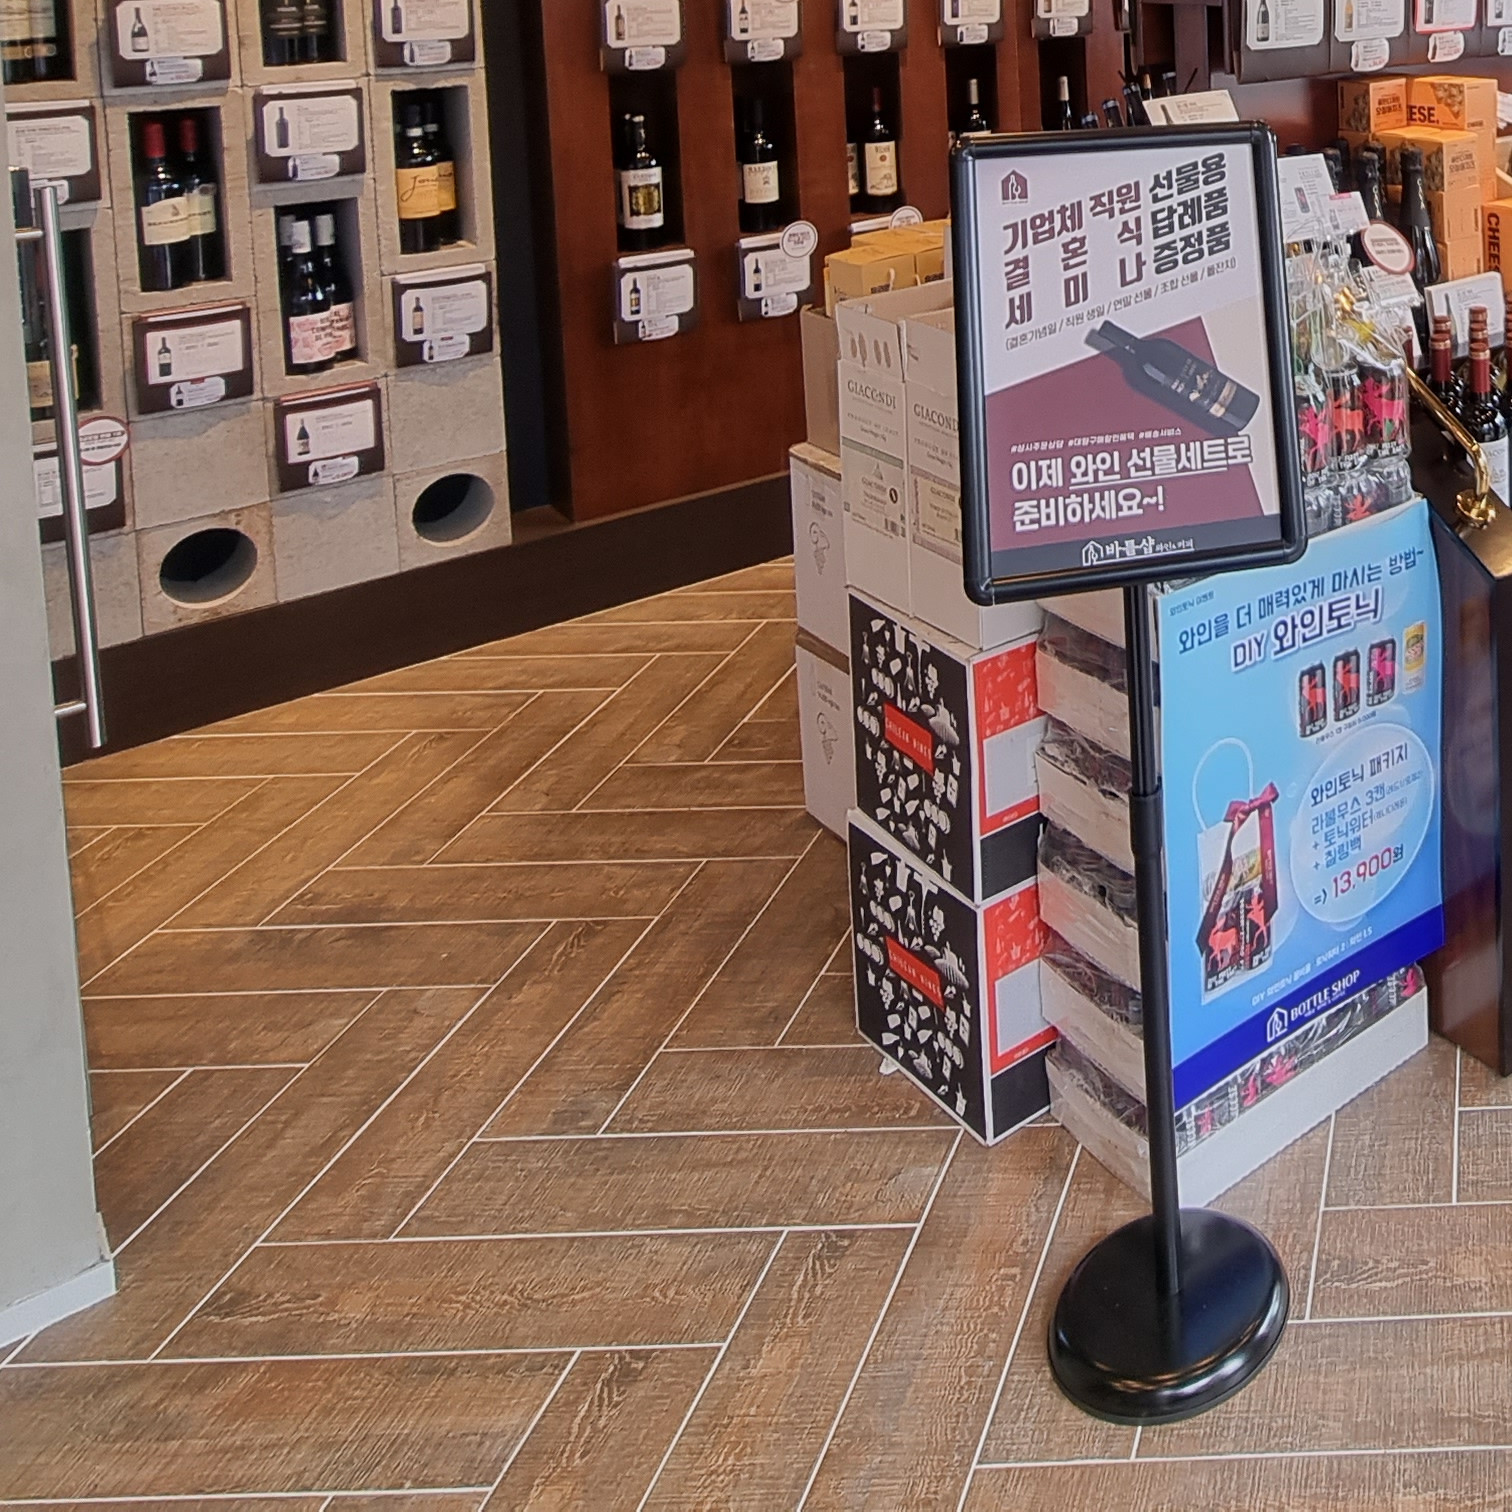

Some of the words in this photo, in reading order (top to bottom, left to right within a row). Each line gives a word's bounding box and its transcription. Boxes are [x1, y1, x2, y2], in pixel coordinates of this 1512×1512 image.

[1407, 104, 1440, 125] ESE.
[1002, 200, 1084, 256] 기업체
[1089, 180, 1142, 219] 직원
[1149, 152, 1226, 204] 선물용
[1004, 254, 1031, 292] 결
[1061, 234, 1089, 272] 혼
[1117, 216, 1143, 246] 식
[1151, 186, 1229, 240] 답례품
[1005, 291, 1032, 330] 세
[1064, 271, 1089, 308] 미
[1119, 252, 1147, 288] 나
[1153, 221, 1231, 275] 증정품
[1065, 312, 1085, 328] 직원
[914, 403, 959, 432] GIACOND
[1012, 457, 1063, 492] 이제
[1069, 449, 1121, 485] 와인
[1127, 434, 1253, 478] 선물세트로
[1013, 485, 1165, 532] 준비하세요~!
[1178, 613, 1229, 655] 와인을
[1236, 607, 1252, 630] 더
[1258, 576, 1325, 620] 매력있게
[1332, 562, 1382, 593] 마시는
[1273, 588, 1382, 656] 와인토닉
[1233, 633, 1268, 668] DIY
[1311, 763, 1365, 807] 와인토닉
[1369, 742, 1408, 776] 패키지
[1365, 782, 1386, 807] 3캔
[1324, 808, 1374, 849] 토닉워터
[1290, 986, 1331, 1022] BOTTLE
[1331, 969, 1361, 996] SHOP
